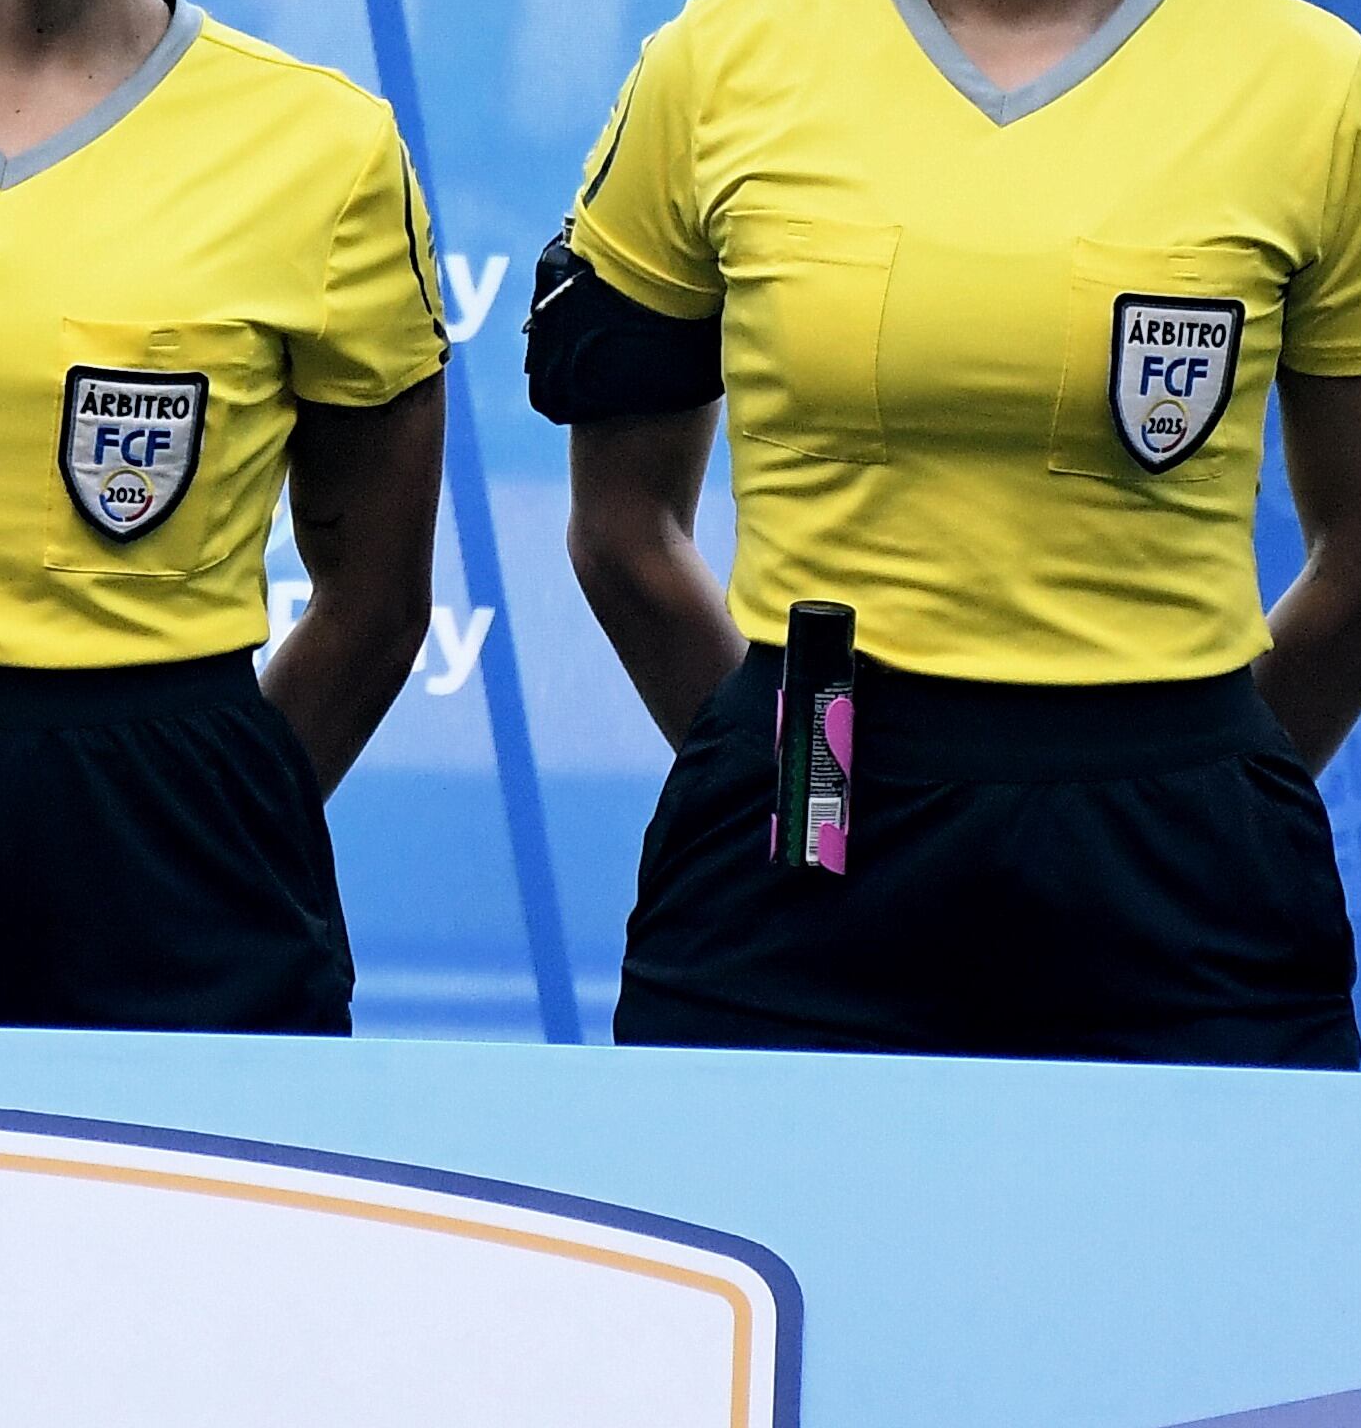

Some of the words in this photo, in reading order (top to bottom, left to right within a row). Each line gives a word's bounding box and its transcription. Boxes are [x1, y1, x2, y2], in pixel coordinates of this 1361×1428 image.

[1128, 311, 1227, 348] ÁRBITRO
[1140, 356, 1209, 397] FCF
[80, 384, 190, 420] ÁRBITRO
[1147, 417, 1184, 435] 2025
[94, 427, 172, 467] FCF
[107, 487, 147, 504] 2025
